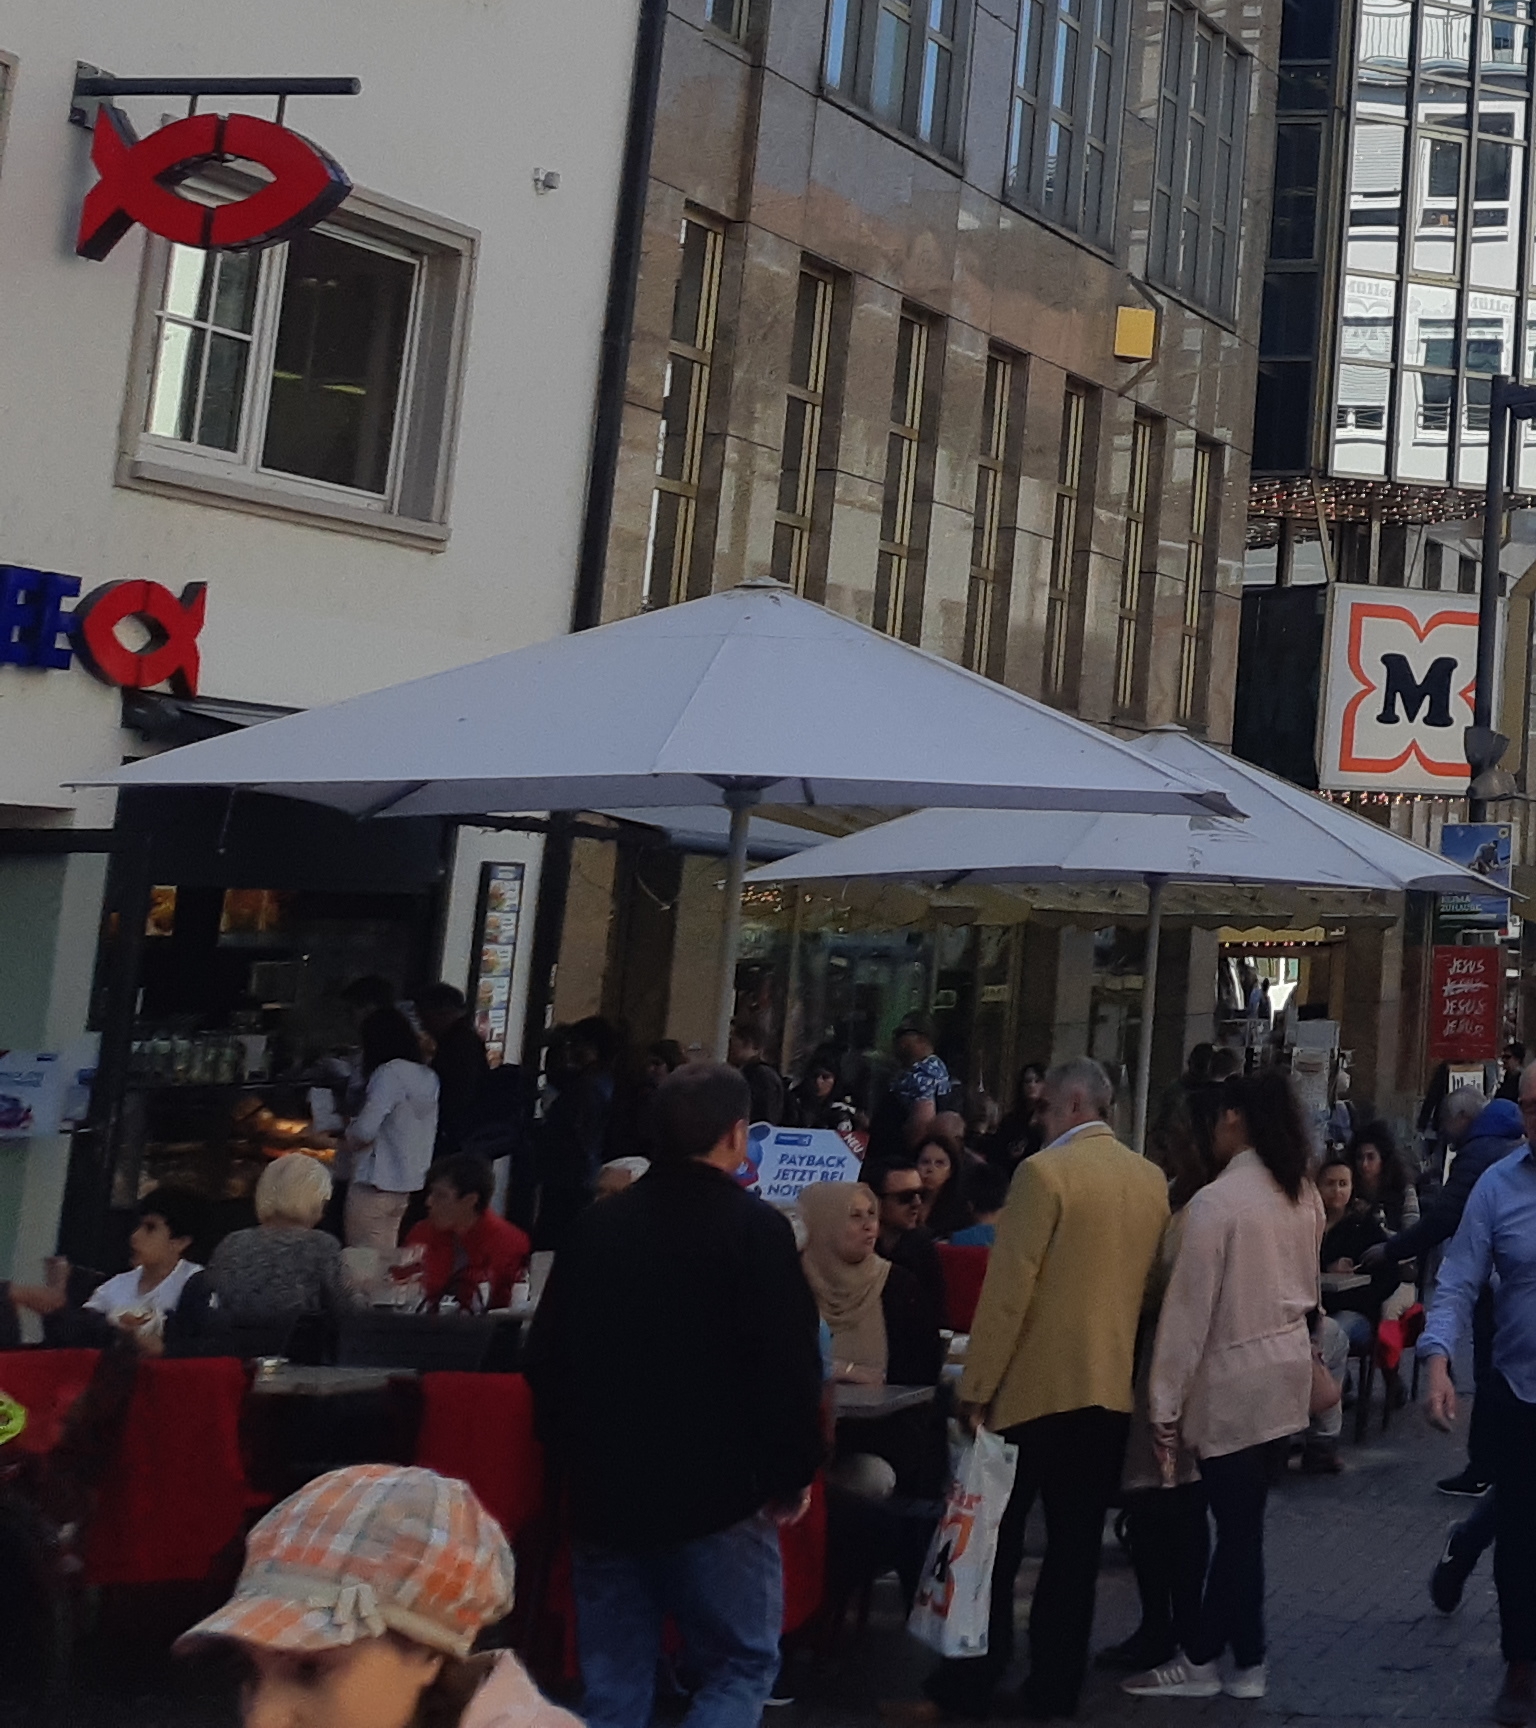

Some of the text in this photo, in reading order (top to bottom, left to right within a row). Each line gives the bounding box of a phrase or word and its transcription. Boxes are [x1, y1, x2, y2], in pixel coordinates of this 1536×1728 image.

[1376, 653, 1458, 728] M
[844, 1133, 865, 1153] NEU
[778, 1153, 848, 1169] PAYBACK
[773, 1168, 845, 1182] JETZT BEI
